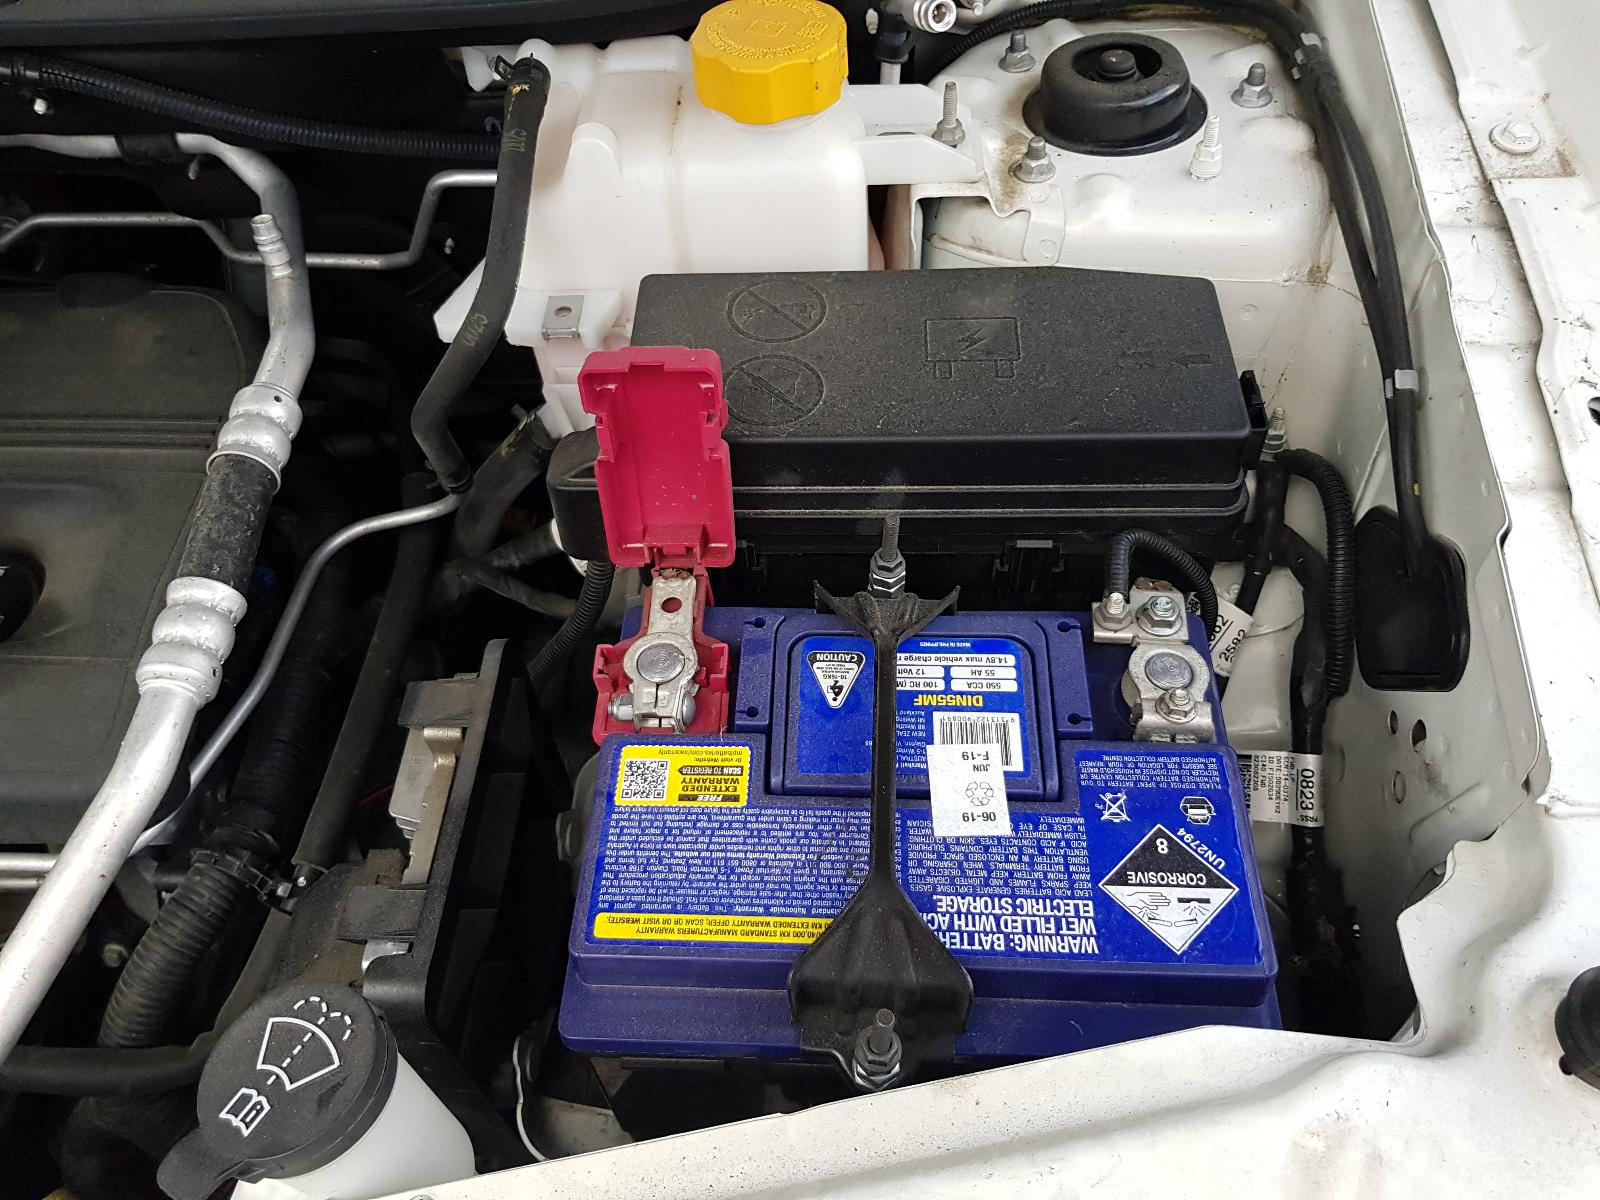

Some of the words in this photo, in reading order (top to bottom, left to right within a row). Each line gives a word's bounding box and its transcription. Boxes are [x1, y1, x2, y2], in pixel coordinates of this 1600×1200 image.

[816, 653, 857, 661] CAUTION
[914, 694, 983, 707] DIN55MF
[962, 751, 989, 761] F-19
[682, 766, 712, 774] REGISTER
[723, 767, 742, 775] SCAN
[681, 777, 739, 785] WARRANTY
[681, 784, 737, 793] EXTENDED
[1300, 768, 1315, 811] 0823
[697, 794, 723, 802] FREE
[962, 812, 996, 822] 06-19
[1018, 830, 1063, 838] IMMEDIATELY
[1001, 838, 1037, 846] CONTACTS
[1156, 838, 1169, 854] 8
[1176, 827, 1226, 870] UN2794
[1034, 855, 1064, 863] BATTERY
[923, 860, 958, 868] CHARGING
[988, 862, 1030, 870] TERMINALS.
[908, 876, 950, 884] CIGARETTES
[1127, 871, 1206, 885] CORROSIVE
[909, 884, 933, 892] GASES.
[936, 885, 973, 893] EXPLOSIVE
[976, 886, 1012, 894] GENERATE
[932, 895, 1013, 914] STORAGE.
[1016, 898, 1094, 916] ELECTRIC
[643, 917, 660, 925] VISIT
[674, 918, 683, 926] QR
[685, 918, 704, 926] SCAN
[732, 920, 771, 928] WARRANTY
[773, 921, 810, 929] EXTENDED
[954, 914, 997, 931] WITH
[1000, 915, 1056, 933] FILLED
[811, 922, 822, 930] KM
[1060, 917, 1096, 935] WET
[635, 926, 675, 935] WARRANTY
[677, 927, 738, 936] MANUFACTURERS
[740, 929, 778, 938] STANDARD
[780, 930, 791, 938] KM
[1010, 934, 1098, 953] WARNING:
